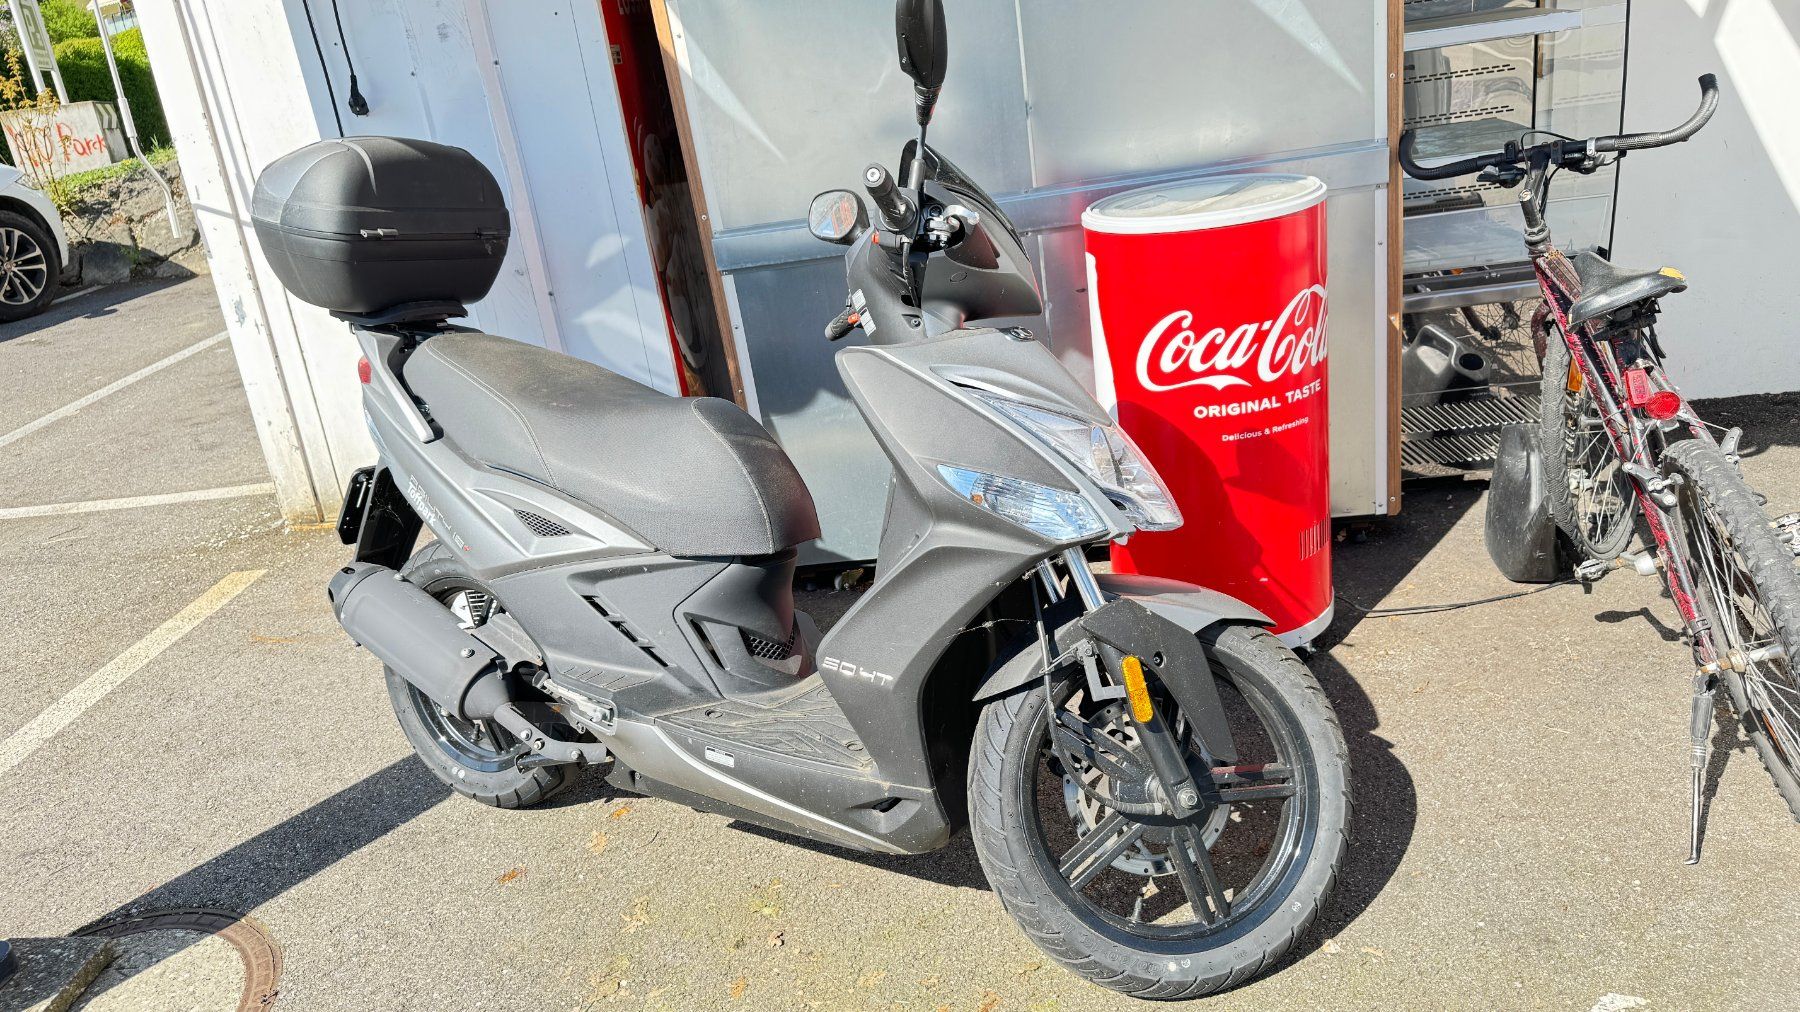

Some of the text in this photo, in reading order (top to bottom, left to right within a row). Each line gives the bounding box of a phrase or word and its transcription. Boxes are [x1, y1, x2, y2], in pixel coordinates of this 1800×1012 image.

[1193, 378, 1321, 419] ORIGINAL TASTE
[1221, 416, 1309, 442] Delicious & Refreshing
[407, 481, 438, 526] Toffpark
